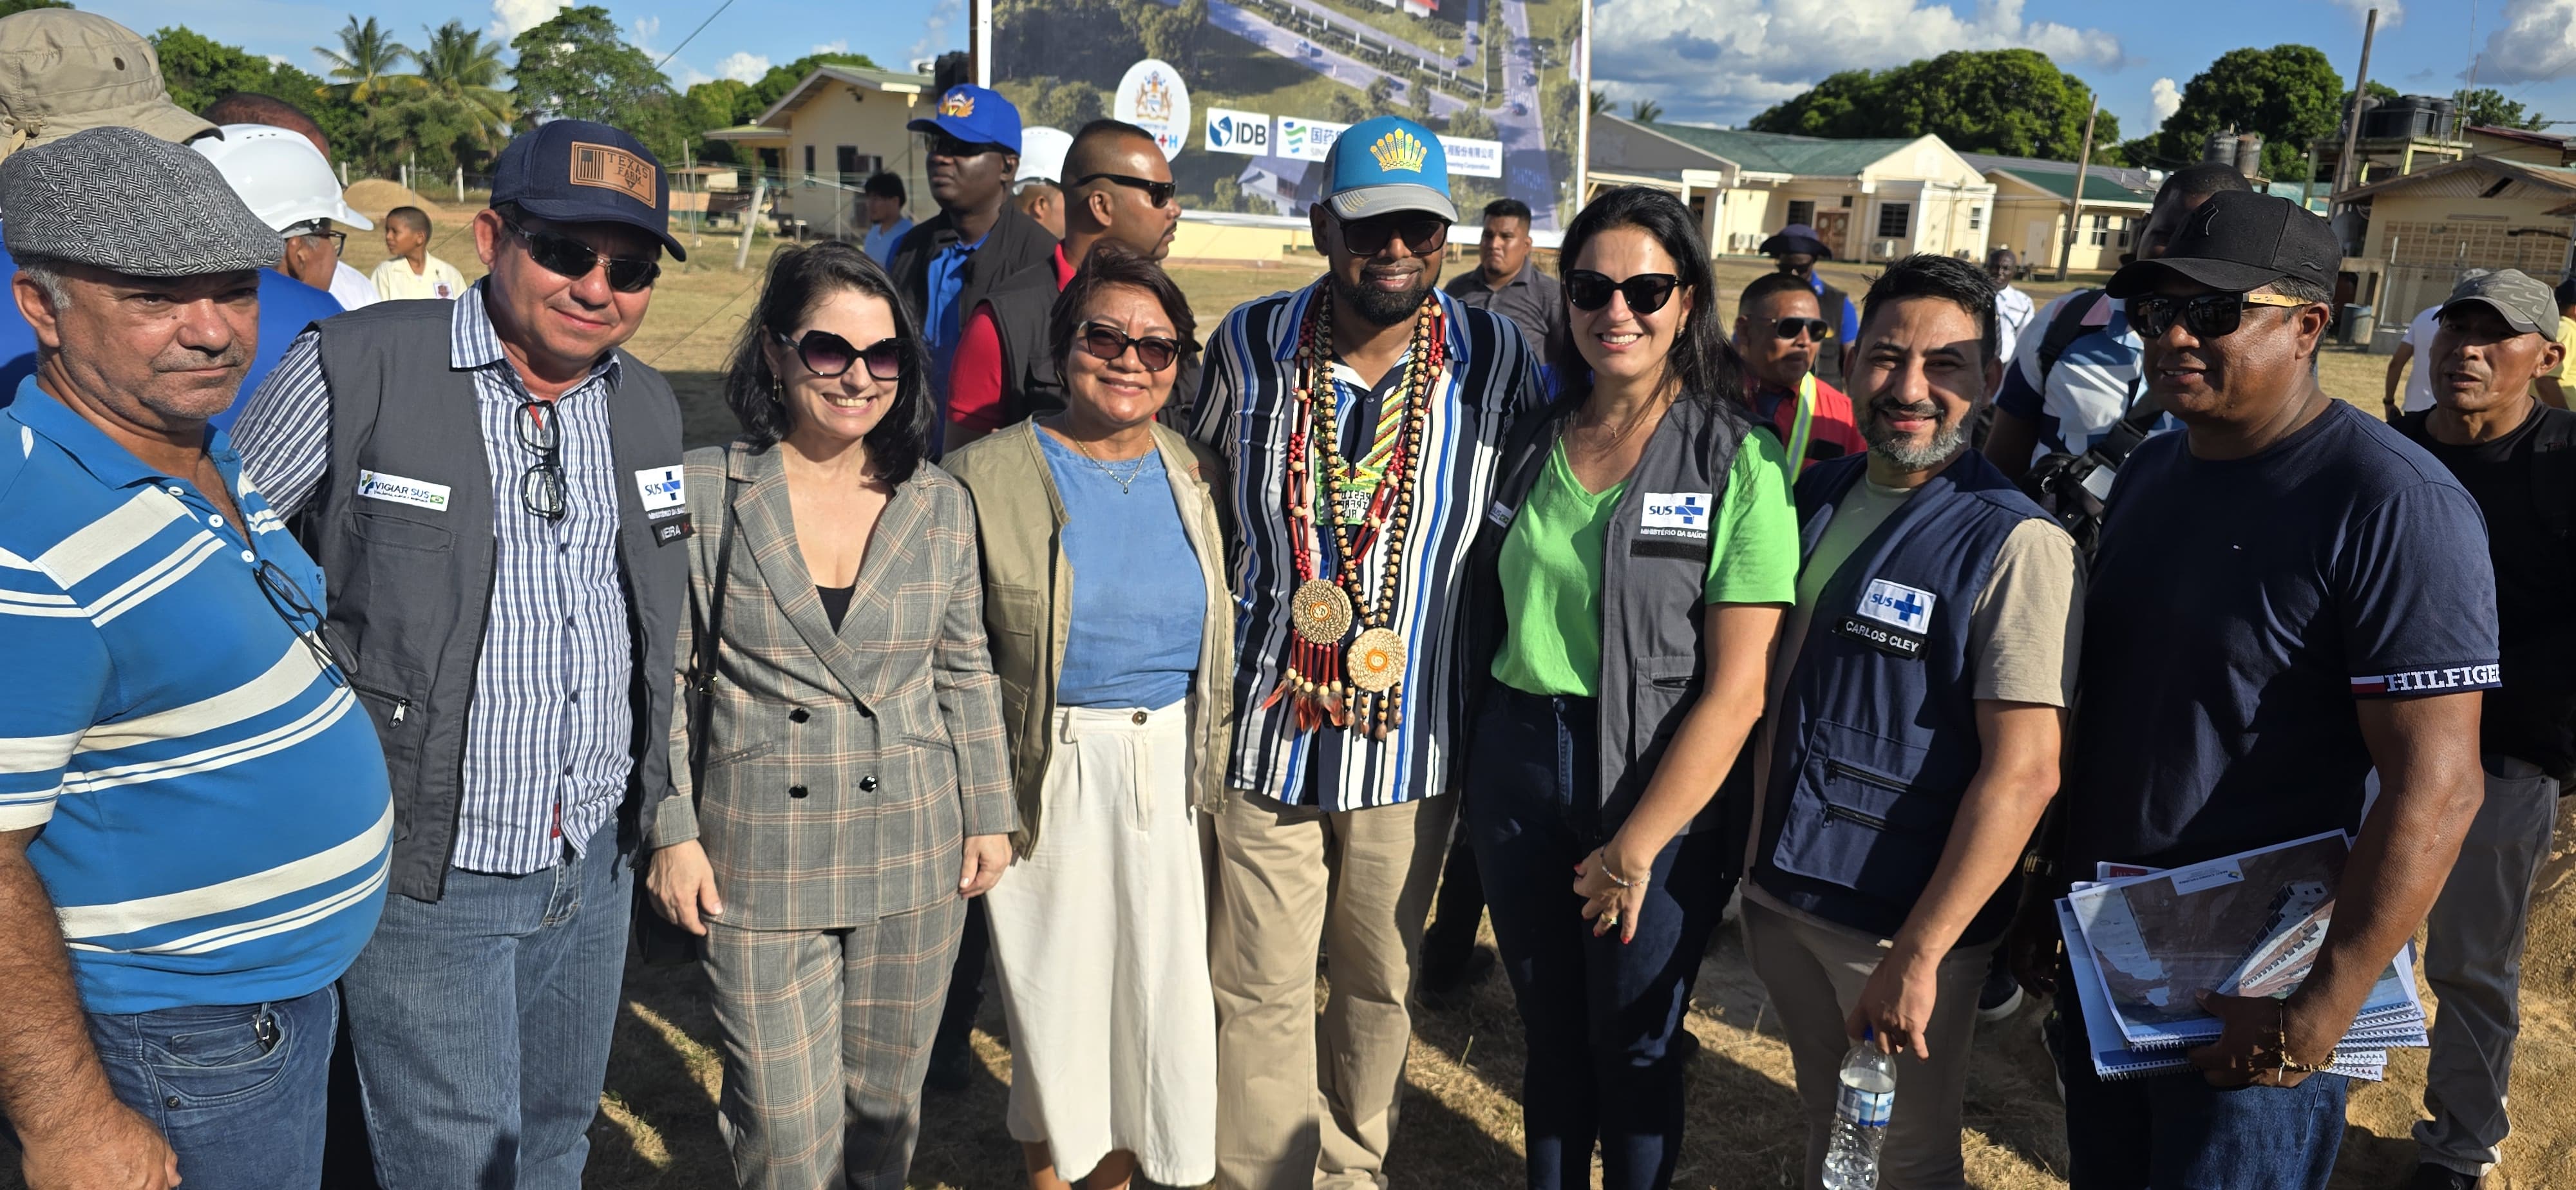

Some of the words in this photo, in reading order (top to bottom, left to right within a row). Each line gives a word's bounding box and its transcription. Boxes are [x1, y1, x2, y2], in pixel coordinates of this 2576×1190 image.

[1236, 122, 1267, 146] IDB
[607, 152, 648, 178] TEXAS
[618, 166, 642, 185] FARM
[375, 481, 409, 495] VIGIAR
[411, 487, 430, 499] SUS
[645, 483, 662, 496] SUS
[1649, 505, 1673, 516] SUS
[1687, 531, 1708, 540] SAÚDE
[1870, 593, 1893, 607] SUS
[1846, 621, 1888, 643] CARLOS
[1889, 636, 1920, 652] CLEY
